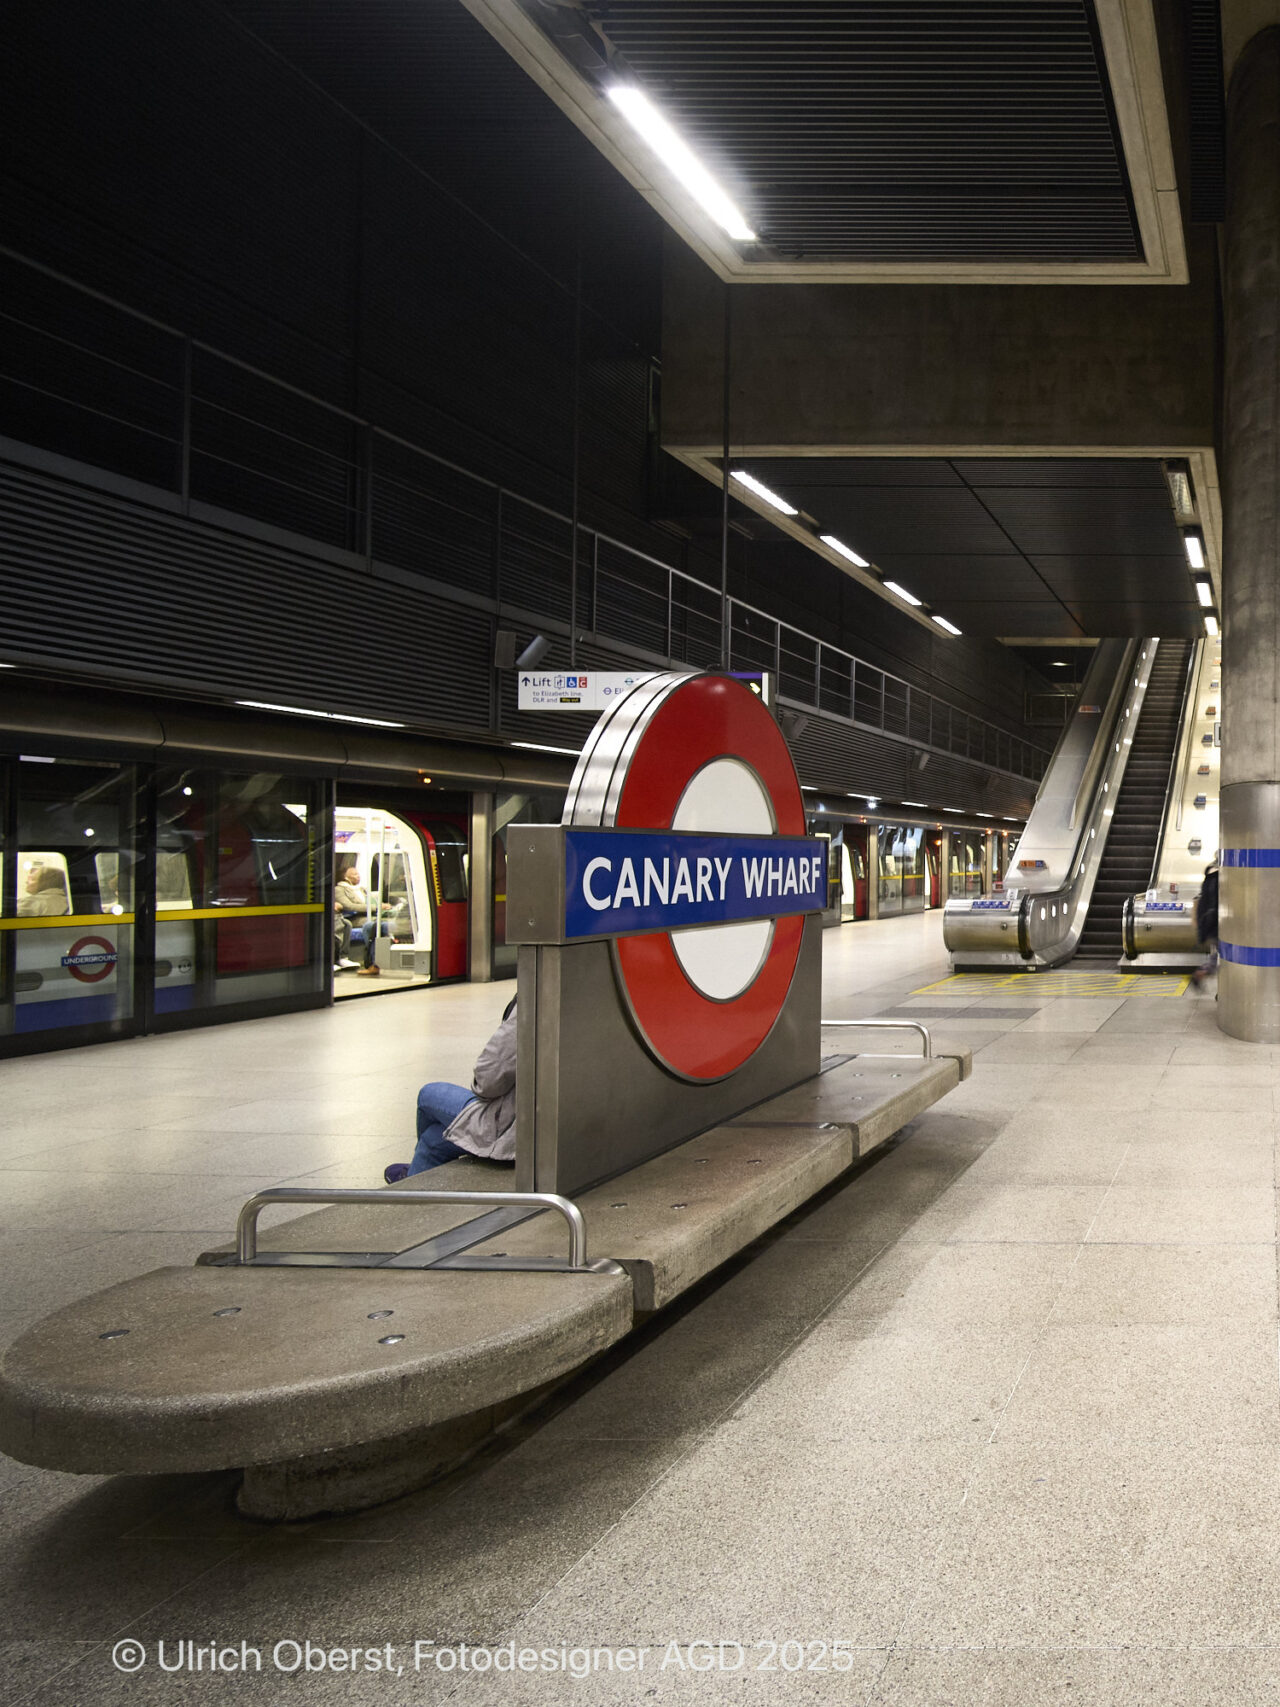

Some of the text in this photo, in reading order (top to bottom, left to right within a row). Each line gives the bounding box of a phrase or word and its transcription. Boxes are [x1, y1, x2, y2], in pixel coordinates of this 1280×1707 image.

[532, 677, 551, 687] Lift
[582, 856, 821, 911] CANARY WHARF
